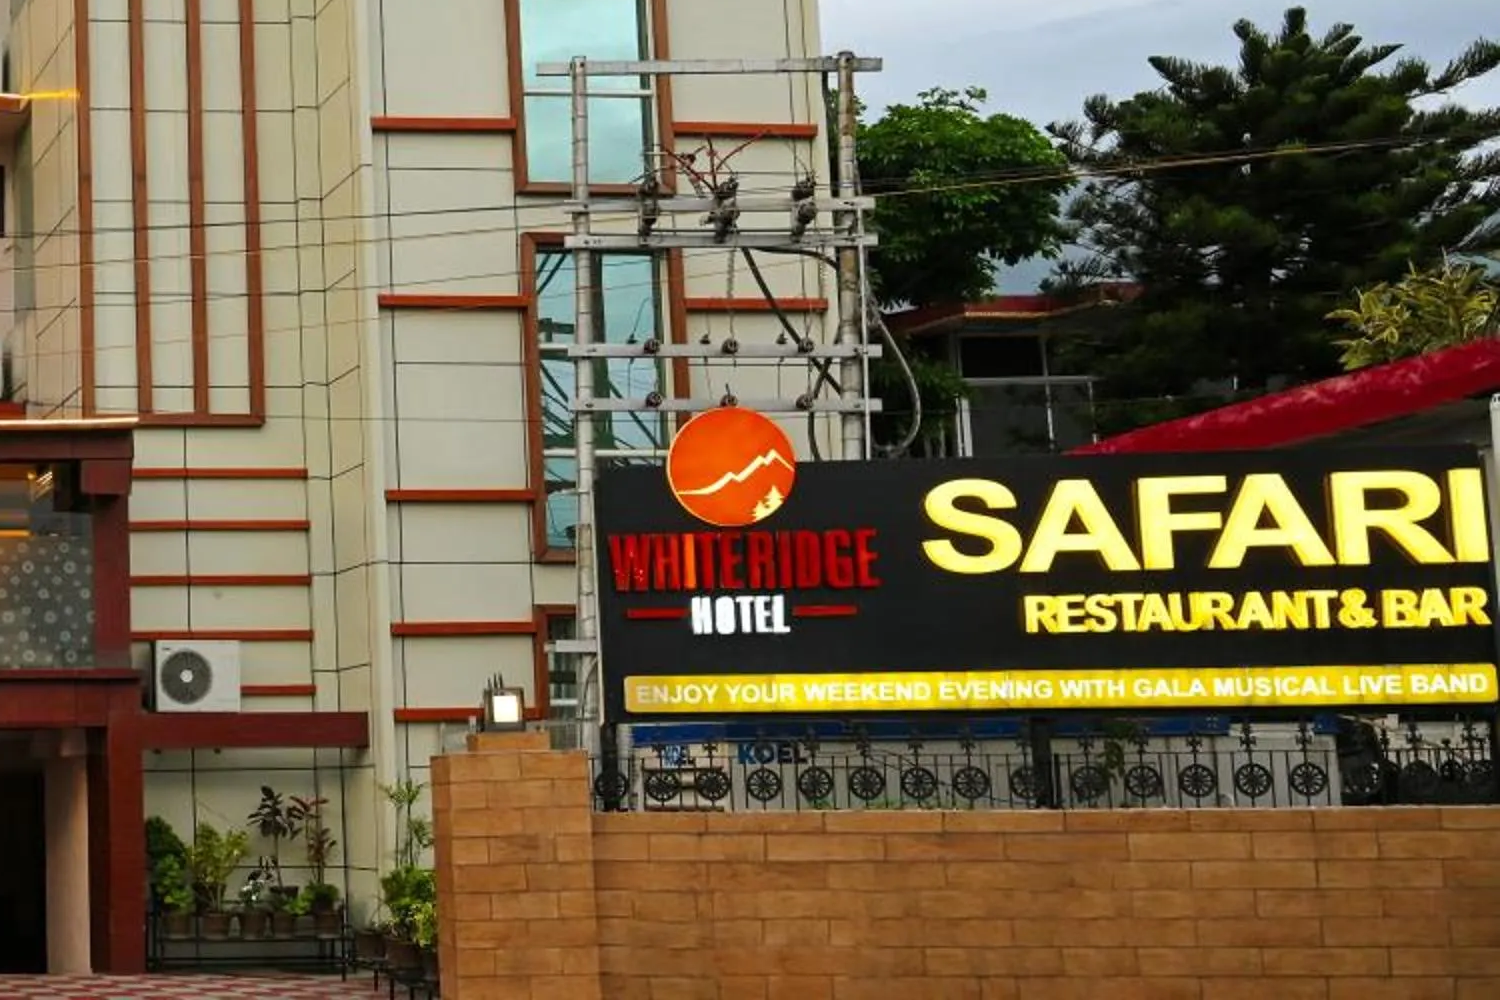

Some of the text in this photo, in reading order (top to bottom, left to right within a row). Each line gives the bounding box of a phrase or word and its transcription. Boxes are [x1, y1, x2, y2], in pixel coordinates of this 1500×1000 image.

[921, 467, 1490, 574] SAFARI
[690, 594, 791, 635] HOTEL
[1382, 586, 1492, 629] BAR
[635, 672, 1489, 704] ENJOY YOUR WEEKEND EVENING WITH GALA MUSICAL LIVE BAND
